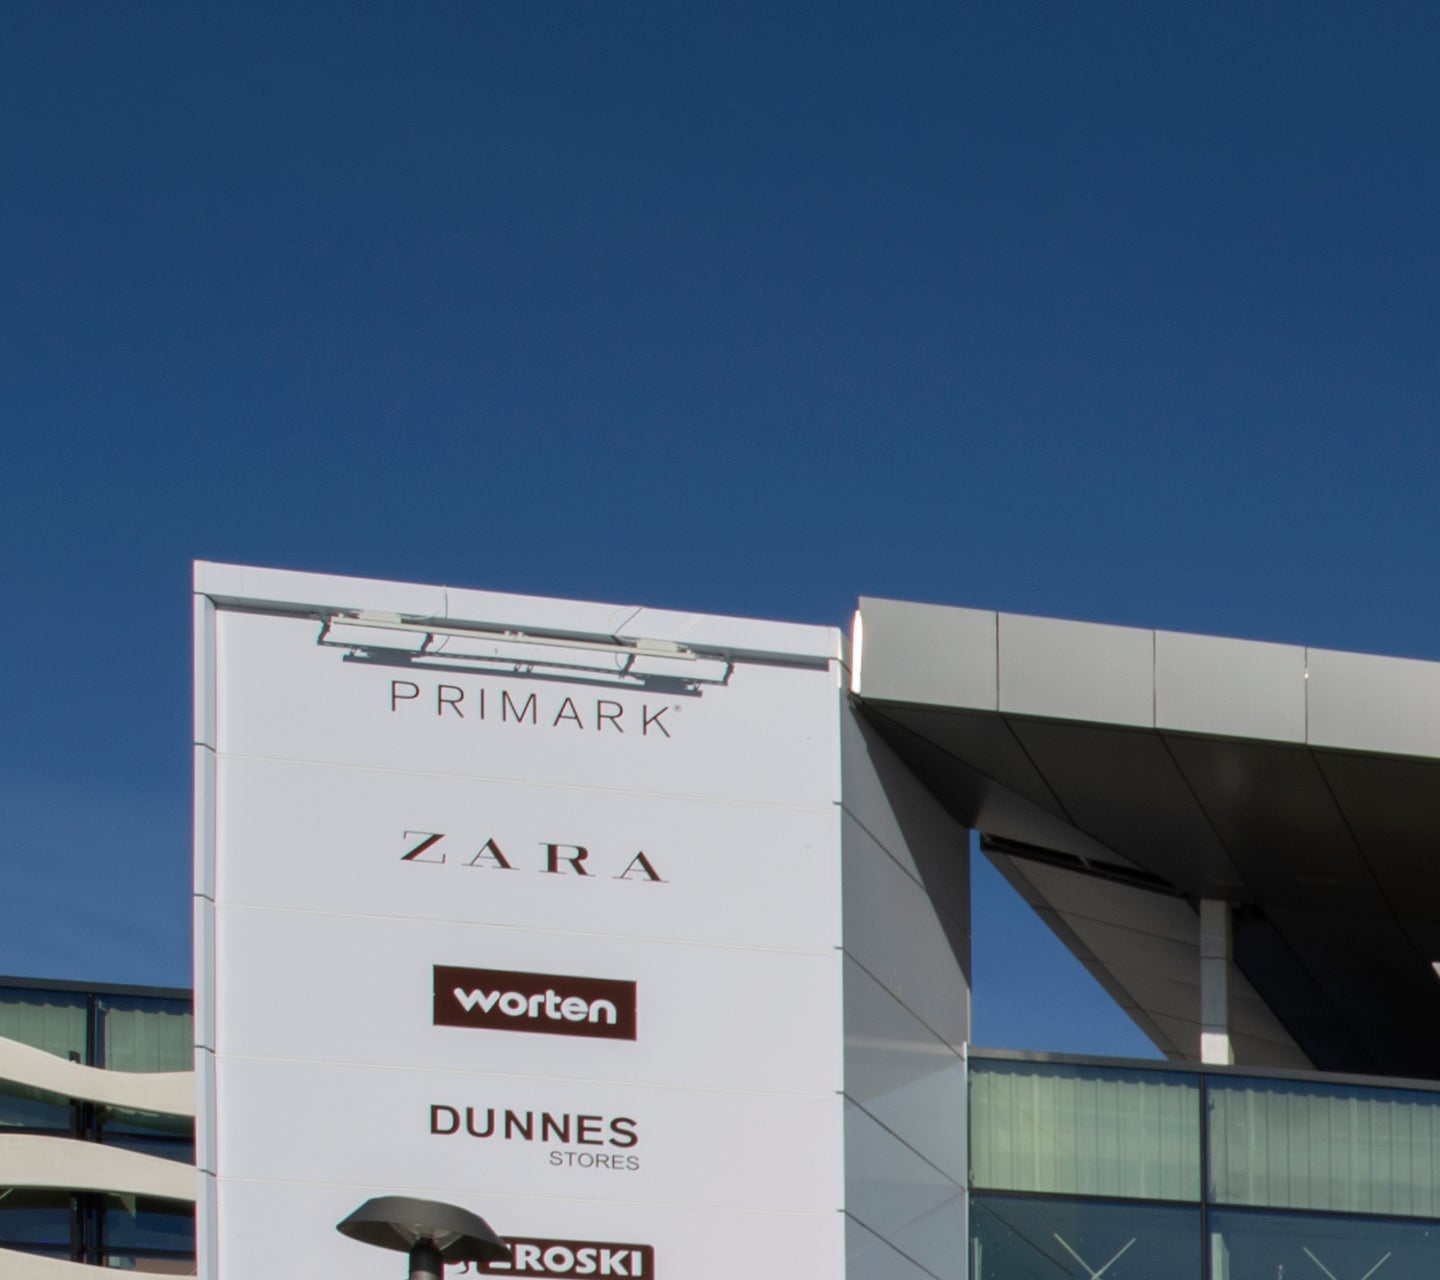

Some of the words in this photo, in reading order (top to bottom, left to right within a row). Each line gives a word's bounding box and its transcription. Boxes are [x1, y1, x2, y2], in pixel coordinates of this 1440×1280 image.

[400, 830, 671, 884] ZARA
[453, 986, 618, 1026] worten
[430, 1104, 639, 1149] DUNNES
[549, 1150, 641, 1172] STORES
